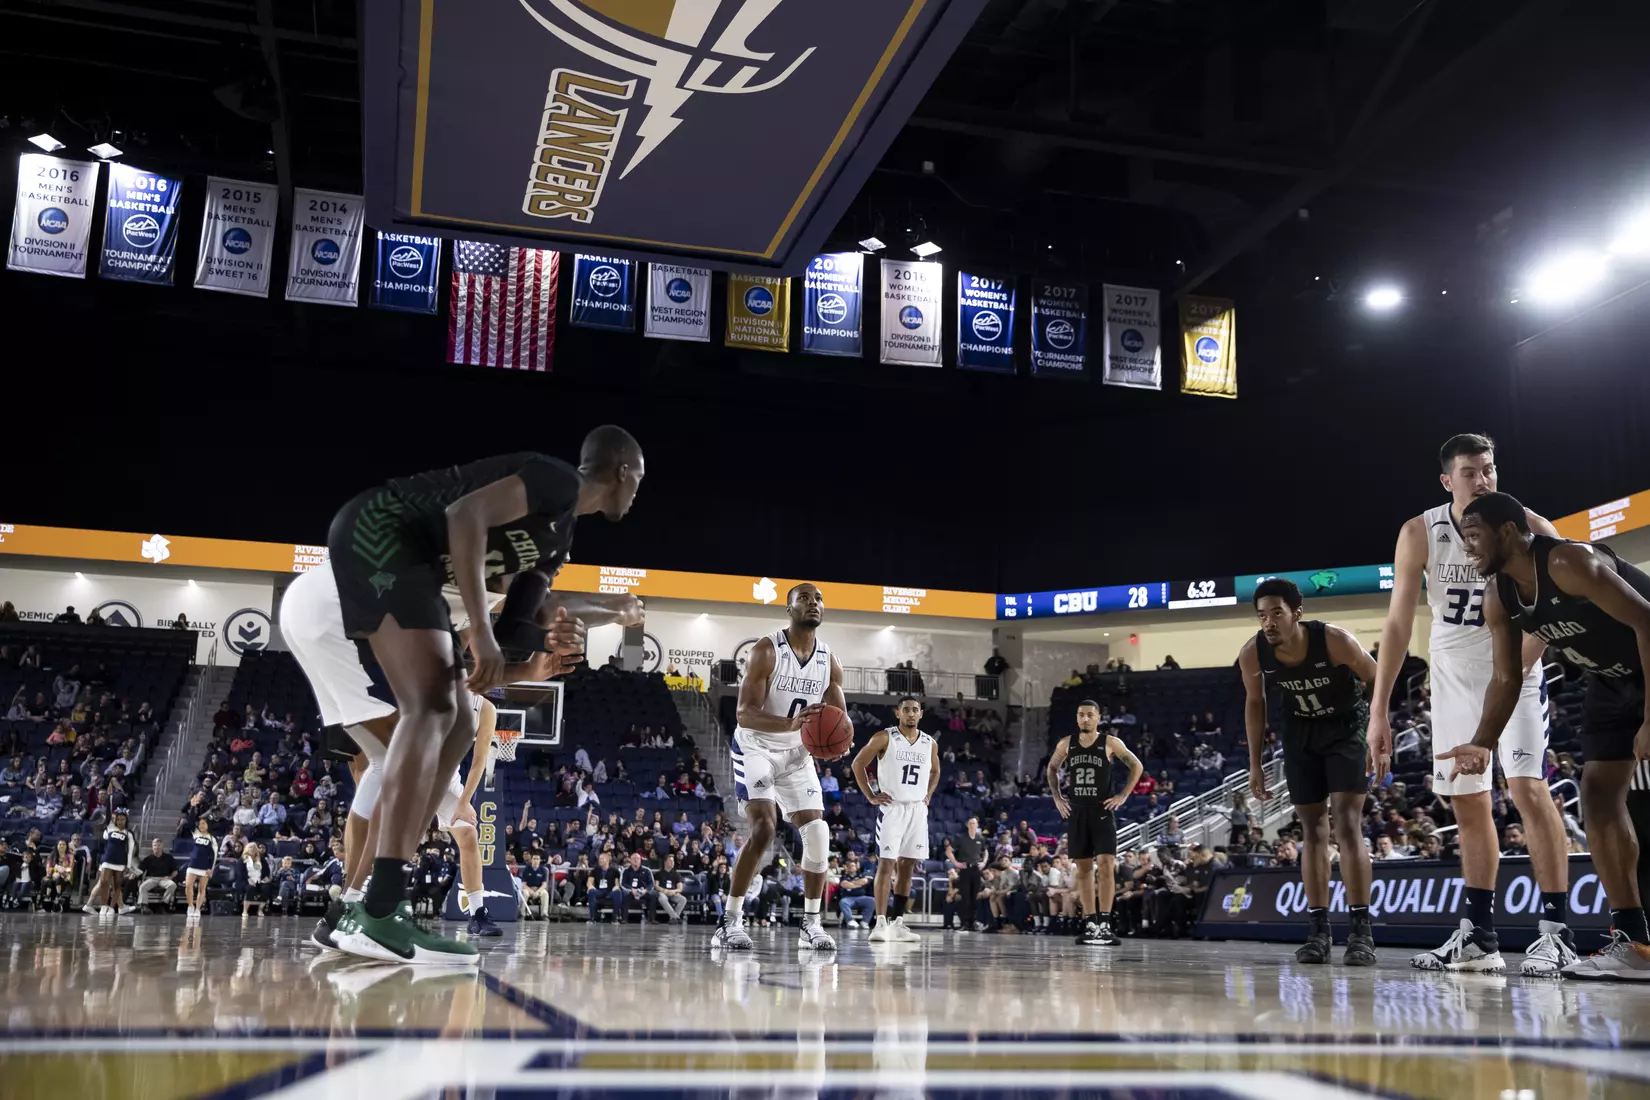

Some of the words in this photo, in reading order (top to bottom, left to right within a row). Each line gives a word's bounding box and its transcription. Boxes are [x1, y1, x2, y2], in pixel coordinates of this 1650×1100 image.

[522, 68, 638, 224] LANCERS
[37, 167, 79, 182] 2016
[38, 183, 73, 193] MEN'S
[21, 191, 89, 207] BASKETBALL
[126, 190, 161, 202] MEN'S
[221, 188, 262, 203] 2015
[110, 199, 175, 215] BASKETBALL
[223, 203, 256, 215] MEN'S
[309, 200, 348, 214] 2014
[40, 219, 67, 229] NCAA
[207, 212, 272, 228] BASKETBALL
[310, 215, 342, 225] MEN'S
[295, 224, 358, 238] BASKETBALL
[25, 237, 68, 249] DIVISION
[225, 240, 250, 249] NCAA
[377, 231, 439, 246] BASKETBALL
[13, 244, 84, 260] TOURNAMENT
[104, 249, 172, 265] TOURNAMENT
[314, 251, 338, 260] NCAA
[107, 259, 166, 273] CHAMPIONS
[206, 256, 253, 270] DIVISION
[208, 267, 244, 279] SWEET
[248, 272, 258, 281] 16
[301, 268, 340, 280] DIVISION
[342, 273, 347, 281] II
[651, 264, 709, 277] BASKETBALL
[292, 276, 356, 289] TOURNAMENT
[731, 274, 787, 286] BASKETBALL
[804, 280, 860, 293] BASKETBALL
[970, 276, 1004, 290] 2017
[374, 280, 434, 294] CHAMPIONS
[1044, 285, 1076, 298] 2017
[885, 292, 938, 304] BASKETBALL
[965, 288, 1007, 301] WOMEN'S
[1115, 294, 1147, 307] 2017
[575, 299, 633, 312] CHAMPIONS
[747, 300, 772, 309] NCAA
[960, 297, 1015, 311] BASKETBALL
[1039, 298, 1080, 309] WOMEN'S
[651, 306, 673, 315] WEST
[674, 308, 707, 318] REGION
[1034, 306, 1086, 319] BASKETBALL
[1110, 307, 1151, 318] WOMEN'S
[652, 315, 704, 326] CHAMPIONS
[733, 316, 775, 328] DIVISION
[1107, 316, 1157, 328] BASKETBALL
[734, 325, 781, 336] NATIONAL
[804, 326, 859, 338] CHAMPIONS
[730, 333, 769, 344] RUNNER
[772, 337, 785, 345] UP
[891, 333, 925, 342] DIVISION
[883, 340, 940, 352] TOURNAMENT
[960, 342, 1014, 355] CHAMPIONS
[1034, 350, 1085, 362] TOURNAMENT
[1037, 359, 1083, 371] CHAMPIONS
[294, 555, 326, 564] MEDIC
[600, 567, 646, 577] RIVERSIDE
[600, 576, 640, 586] MEDICAL
[599, 585, 629, 594] CLINIC
[1187, 580, 1216, 598] 6:32
[883, 596, 920, 606] MEDICAL
[1053, 591, 1098, 614] CBU
[1128, 586, 1148, 608] 28
[1027, 606, 1032, 616] 5
[1443, 588, 1486, 627] 33
[669, 649, 715, 659] EQUIPPED
[1562, 646, 1599, 668] 4
[669, 657, 681, 665] TO
[683, 658, 712, 666] SERVE
[777, 675, 822, 695] LANCERS
[1295, 694, 1322, 712] 11
[896, 751, 927, 764] LANCERS
[1070, 754, 1103, 767] CHICAGO
[901, 764, 920, 786] 15
[1076, 768, 1095, 785] 22
[1074, 787, 1098, 797] STATE
